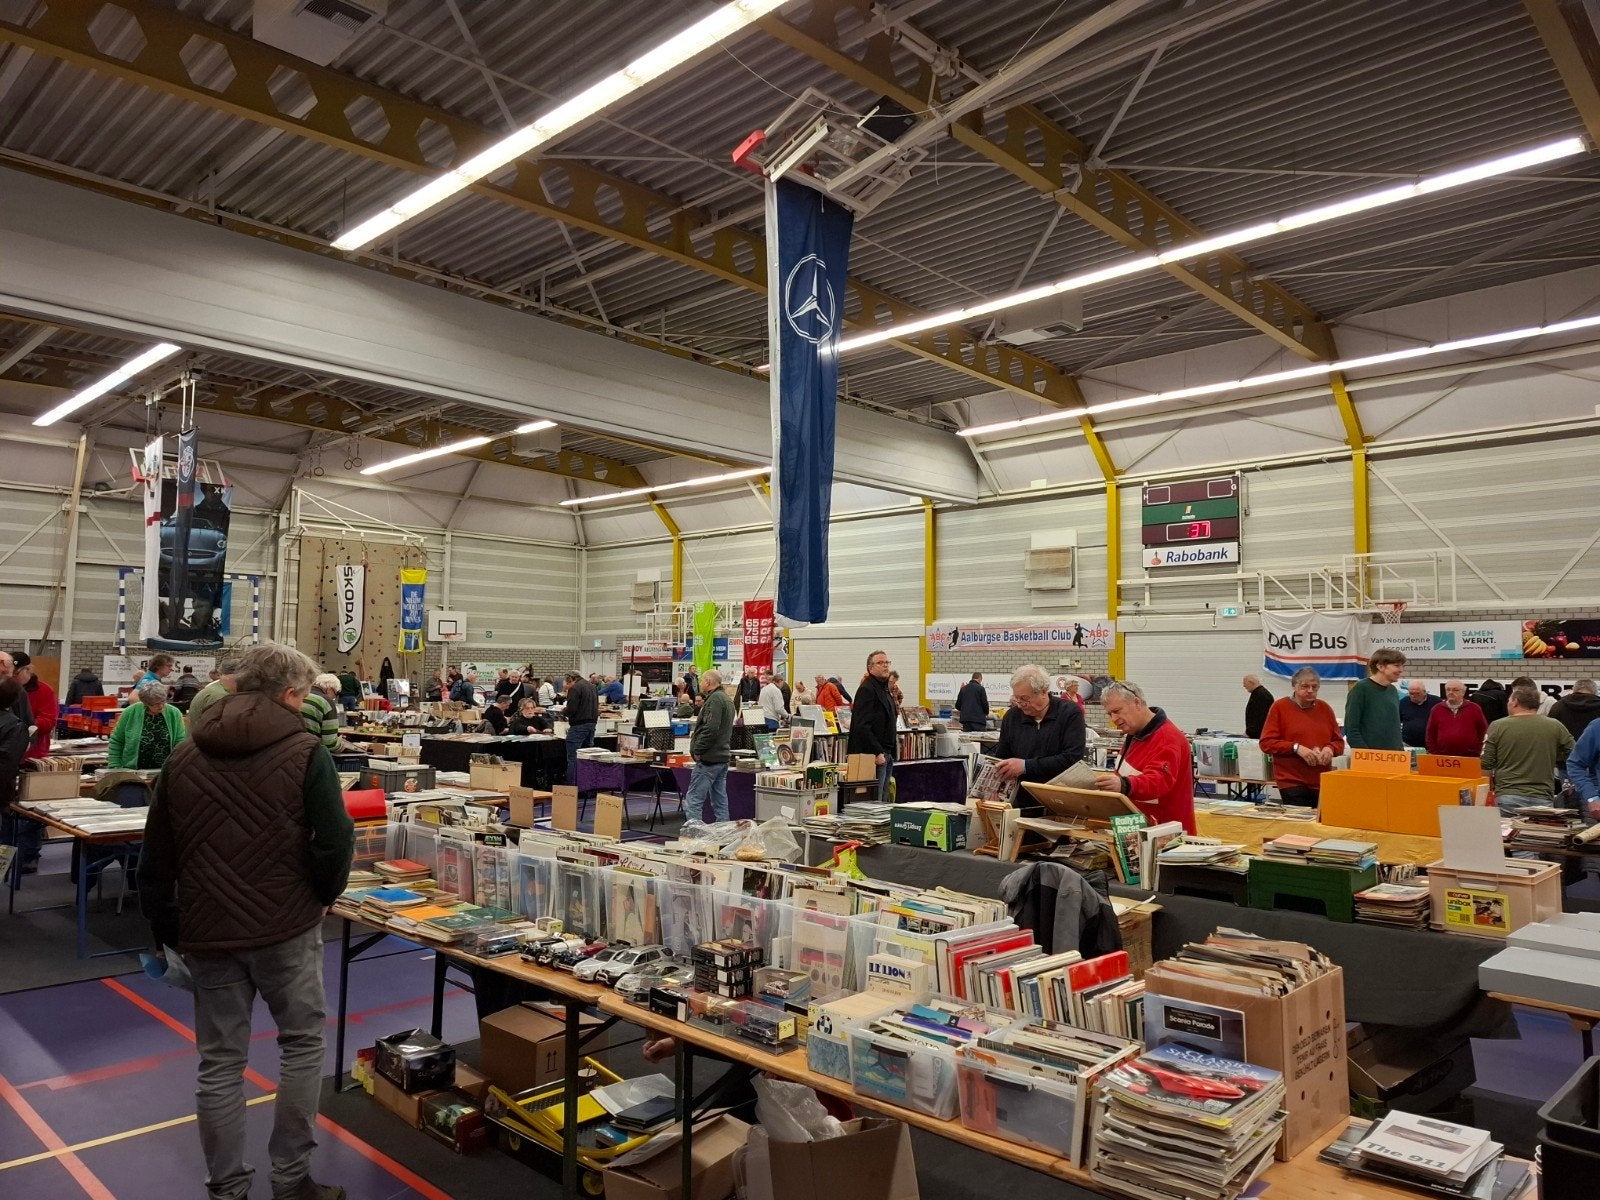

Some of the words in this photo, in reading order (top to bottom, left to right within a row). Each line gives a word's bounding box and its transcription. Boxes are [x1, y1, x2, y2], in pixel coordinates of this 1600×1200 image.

[1166, 547, 1228, 563] Rabobank
[744, 636, 758, 644] 85
[961, 632, 1000, 644] Aalburgse
[1003, 630, 1049, 642] Basketball
[1052, 629, 1072, 640] Club
[1089, 629, 1109, 638] ABC
[1268, 632, 1303, 650] DAF
[1310, 632, 1348, 649] Bus
[1355, 752, 1407, 763] DUITSLAND
[1436, 759, 1461, 768] USA
[1117, 824, 1140, 834] Races
[1169, 1015, 1191, 1026] Scania
[1192, 1019, 1216, 1030] Parade
[1186, 1049, 1252, 1068] CLASSIC
[1366, 1142, 1403, 1158] The
[1408, 1154, 1447, 1169] 911
